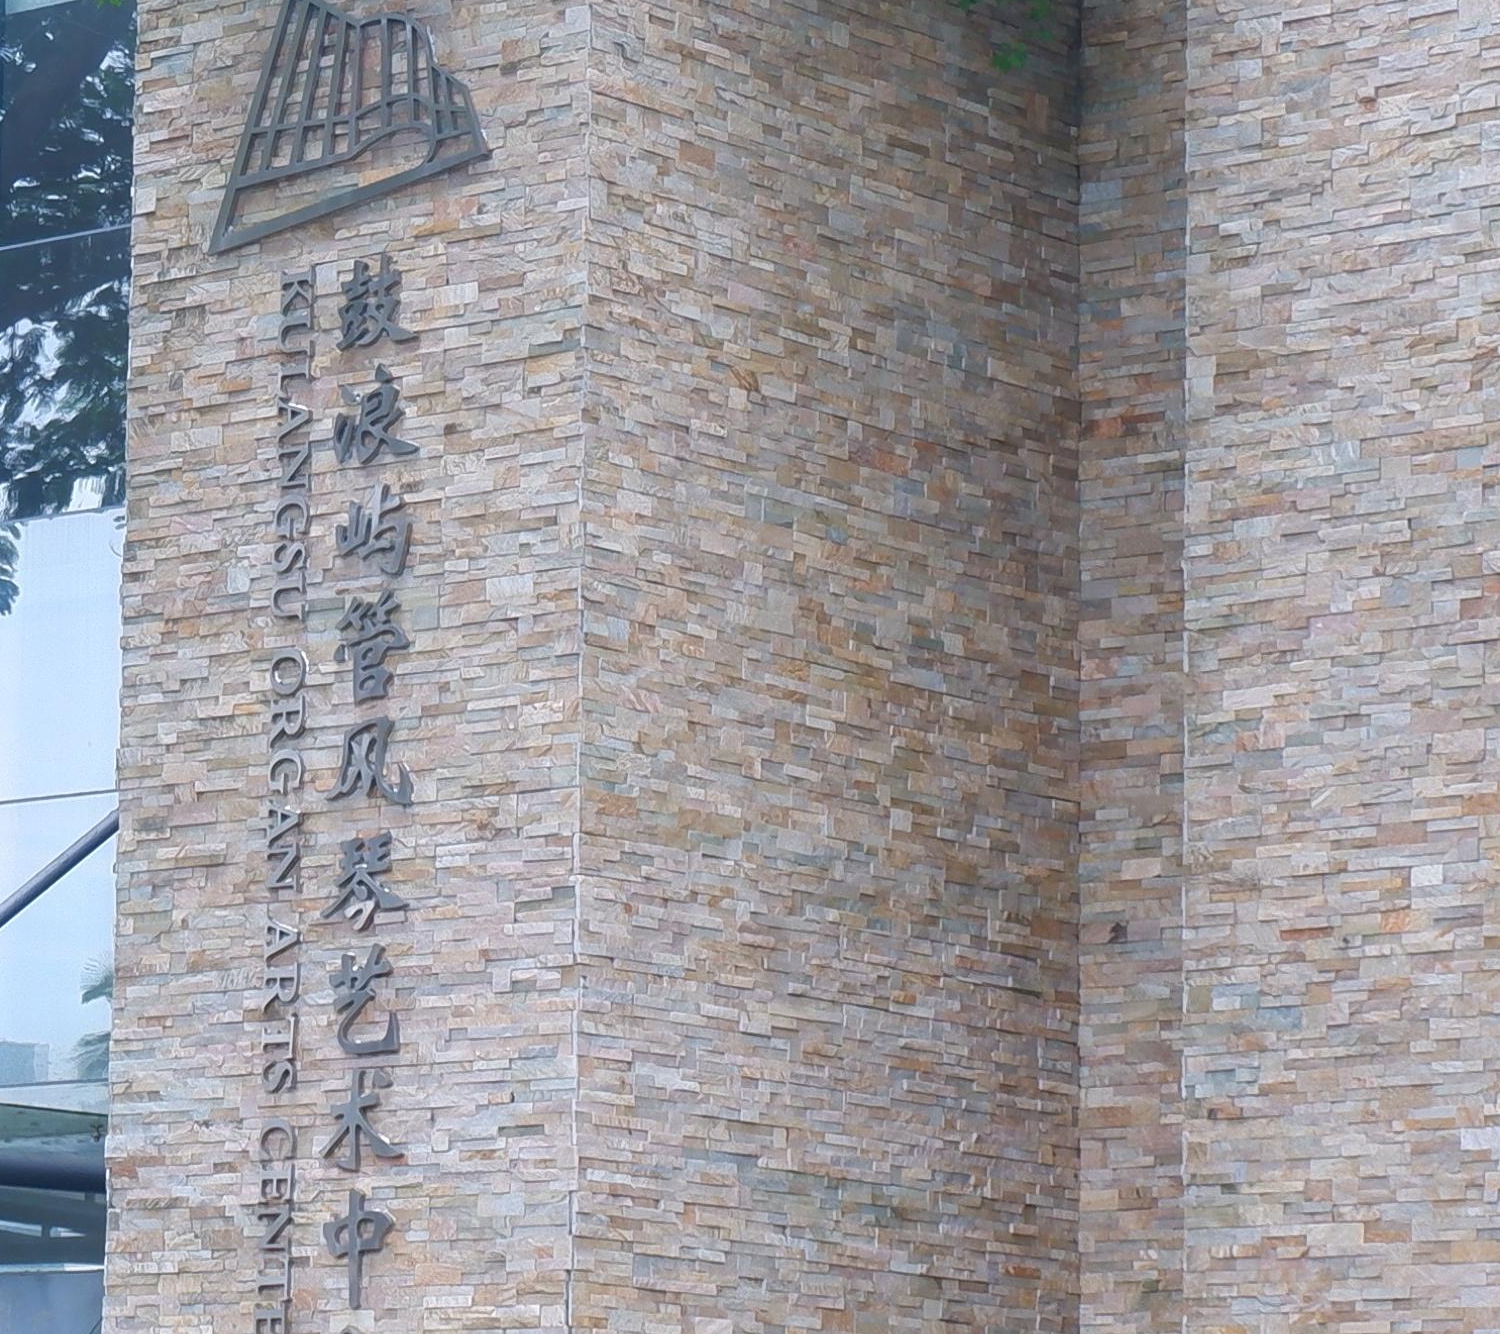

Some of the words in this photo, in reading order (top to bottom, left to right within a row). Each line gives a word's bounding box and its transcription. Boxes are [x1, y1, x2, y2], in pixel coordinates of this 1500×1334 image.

[270, 271, 316, 618] KULANGSU
[265, 648, 307, 891] ORGAN
[259, 920, 301, 1096] ARTS
